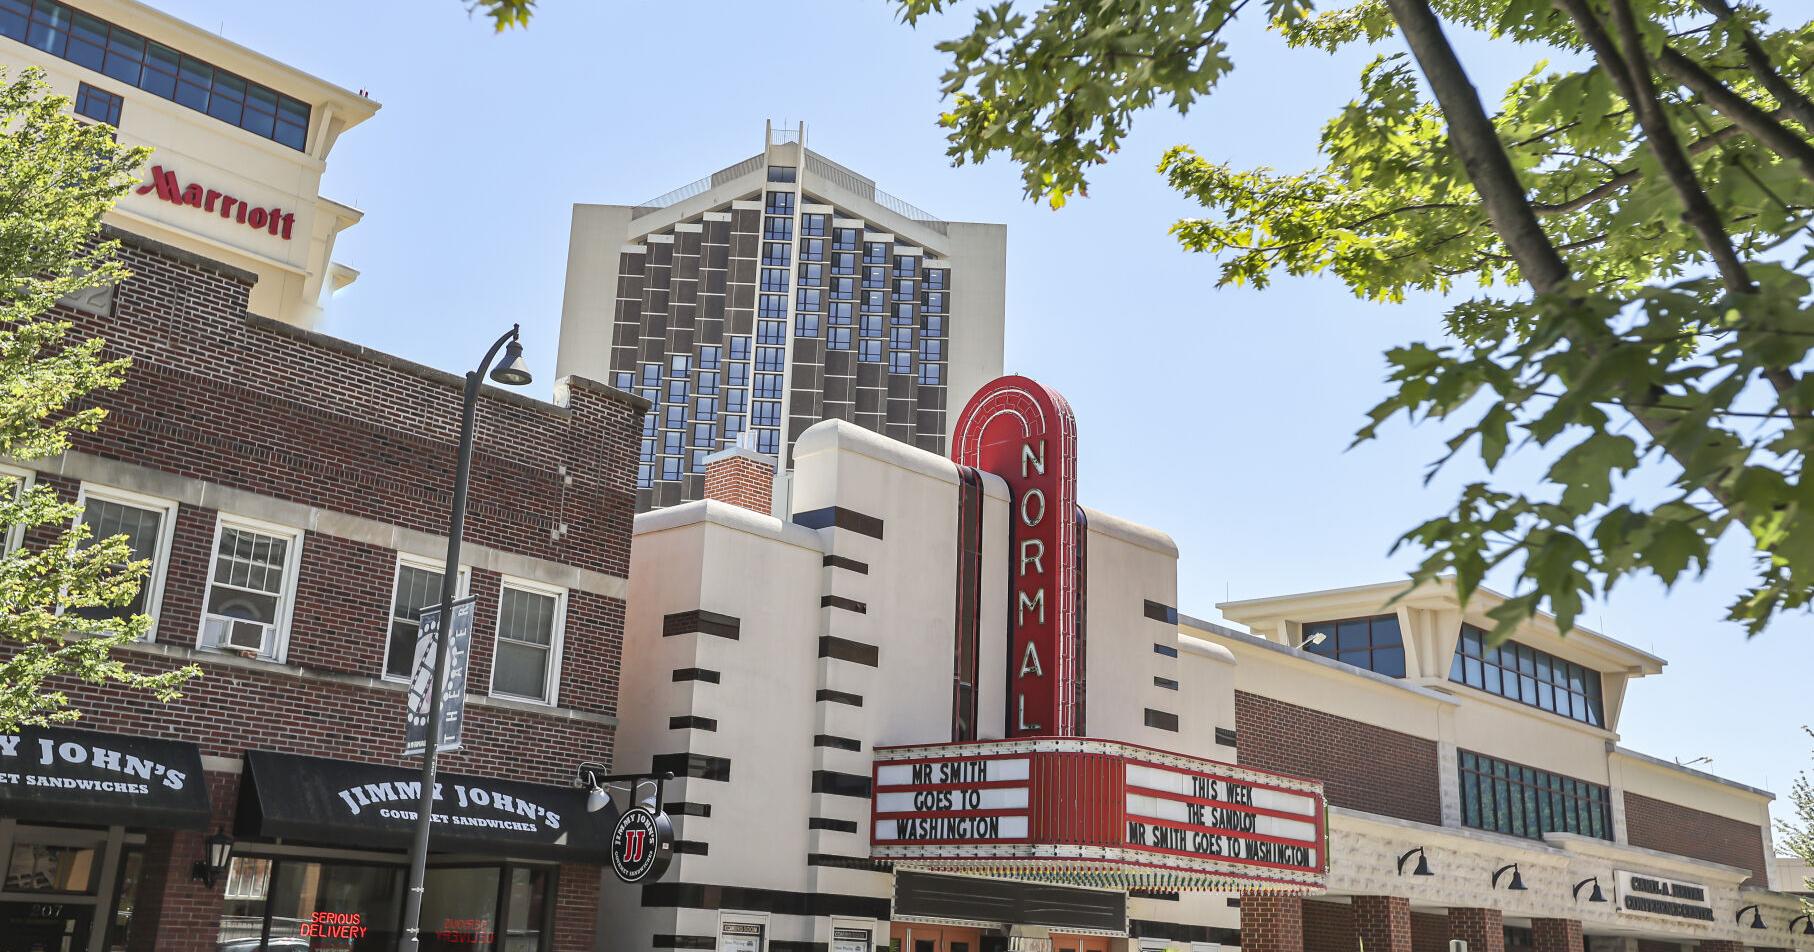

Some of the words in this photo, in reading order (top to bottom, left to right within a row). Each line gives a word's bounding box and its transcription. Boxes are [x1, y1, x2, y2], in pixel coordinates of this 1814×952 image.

[136, 165, 295, 240] Marriott
[1017, 440, 1046, 731] NORMAL
[443, 604, 469, 744] THEATER
[38, 738, 187, 790] JOHN'S
[912, 764, 933, 785] MR
[940, 760, 987, 783] SMITH
[26, 776, 149, 794] SANDWICHES
[914, 790, 952, 811] GOES
[961, 789, 980, 810] TO
[1192, 776, 1218, 800] THIS
[1226, 785, 1253, 807] WEEK
[380, 809, 450, 824] GOURET
[453, 815, 538, 832] SANDWICHES
[454, 785, 561, 829] JOHN'S
[1187, 803, 1205, 825] THE
[1211, 808, 1256, 834] SANDLOT
[615, 814, 636, 845] JIMMY
[637, 813, 655, 846] JOHN'S
[896, 816, 999, 840] WASHINGTON
[623, 830, 646, 862] JJ
[1129, 822, 1146, 846] MR
[1152, 826, 1186, 850] SMITH
[1193, 832, 1222, 857] GOES
[1227, 836, 1241, 858] TO
[1245, 839, 1310, 867] WASHINGTON
[300, 923, 367, 939] DELIVERY
[311, 911, 361, 925] SERIOUS
